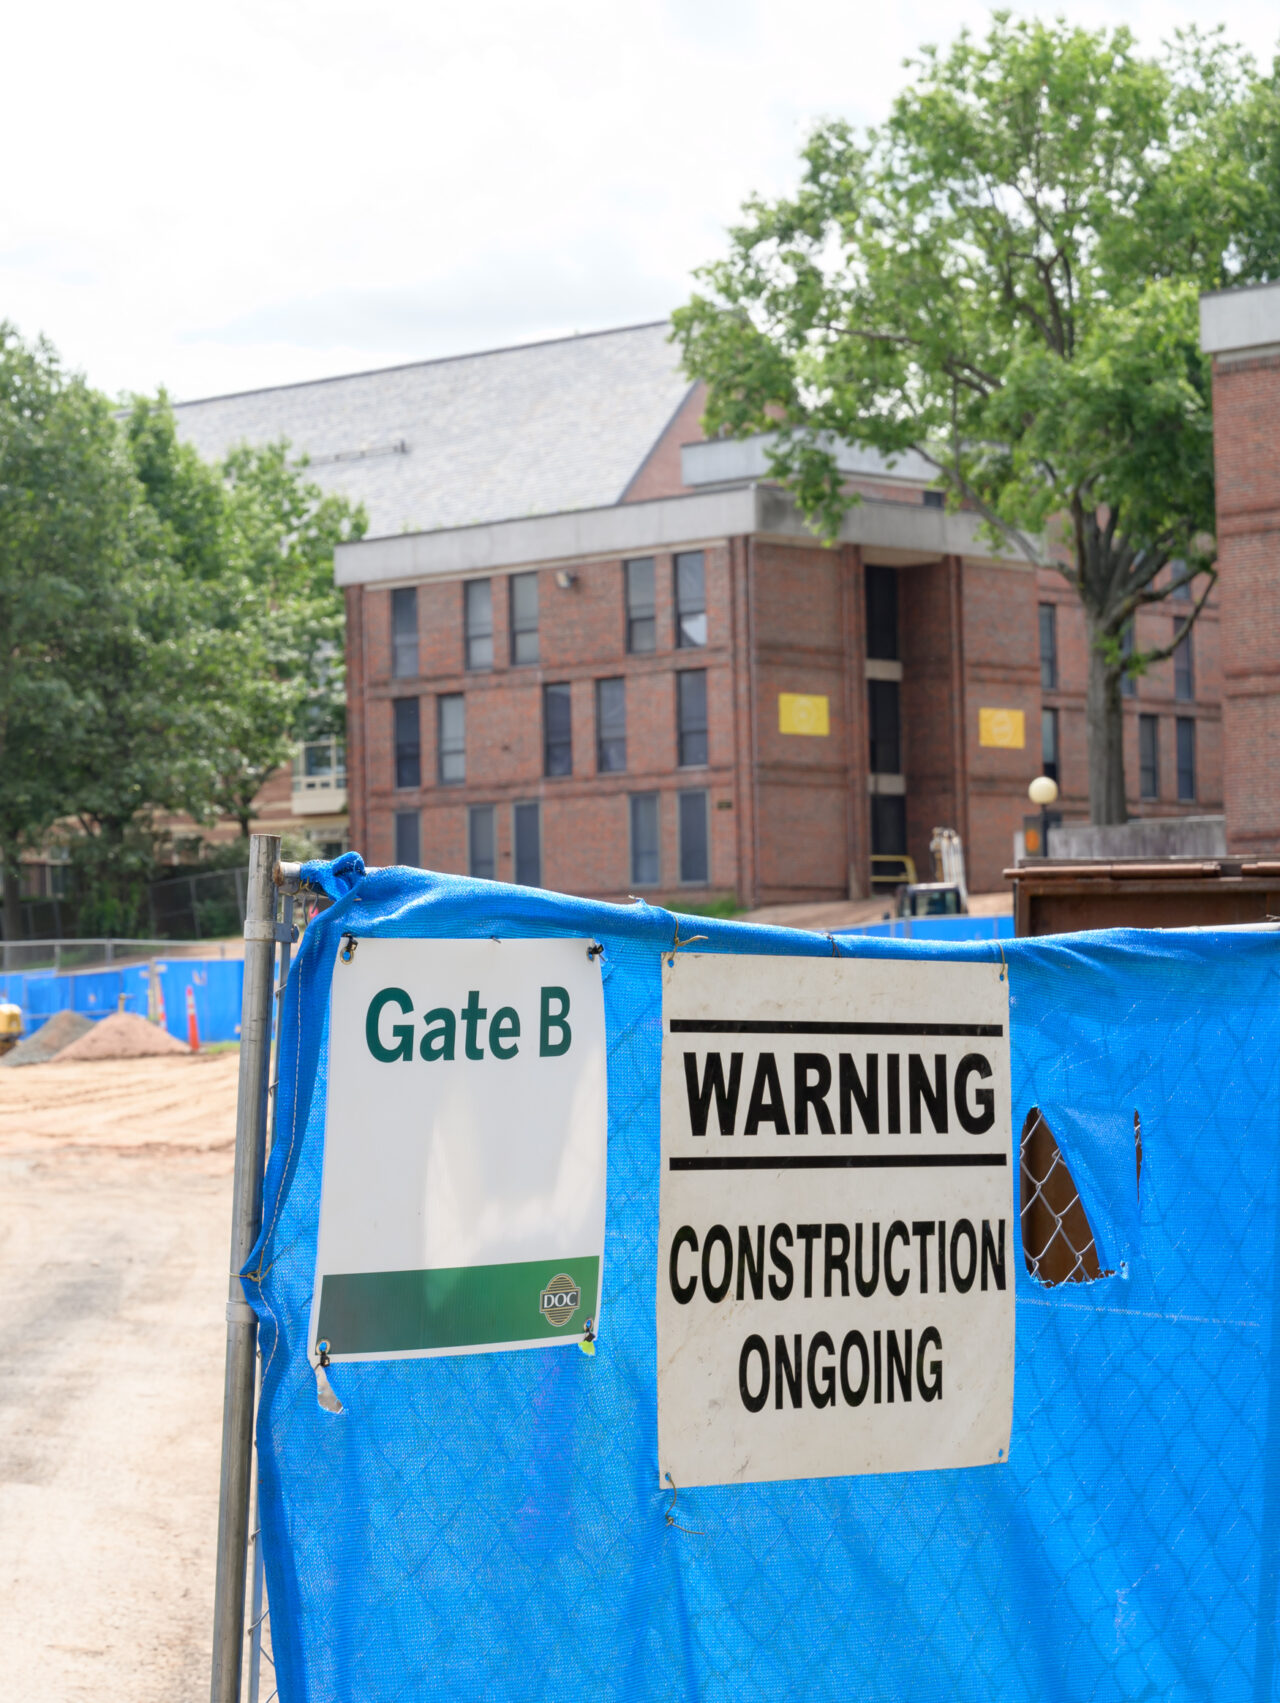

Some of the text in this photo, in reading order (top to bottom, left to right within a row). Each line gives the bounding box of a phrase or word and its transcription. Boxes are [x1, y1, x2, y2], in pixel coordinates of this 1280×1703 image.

[366, 986, 572, 1063] Gate B
[683, 1052, 995, 1136] WARNING
[543, 1292, 577, 1308] DOC
[669, 1219, 1006, 1304] CONSTRUCTION
[739, 1326, 943, 1412] ONGOING
